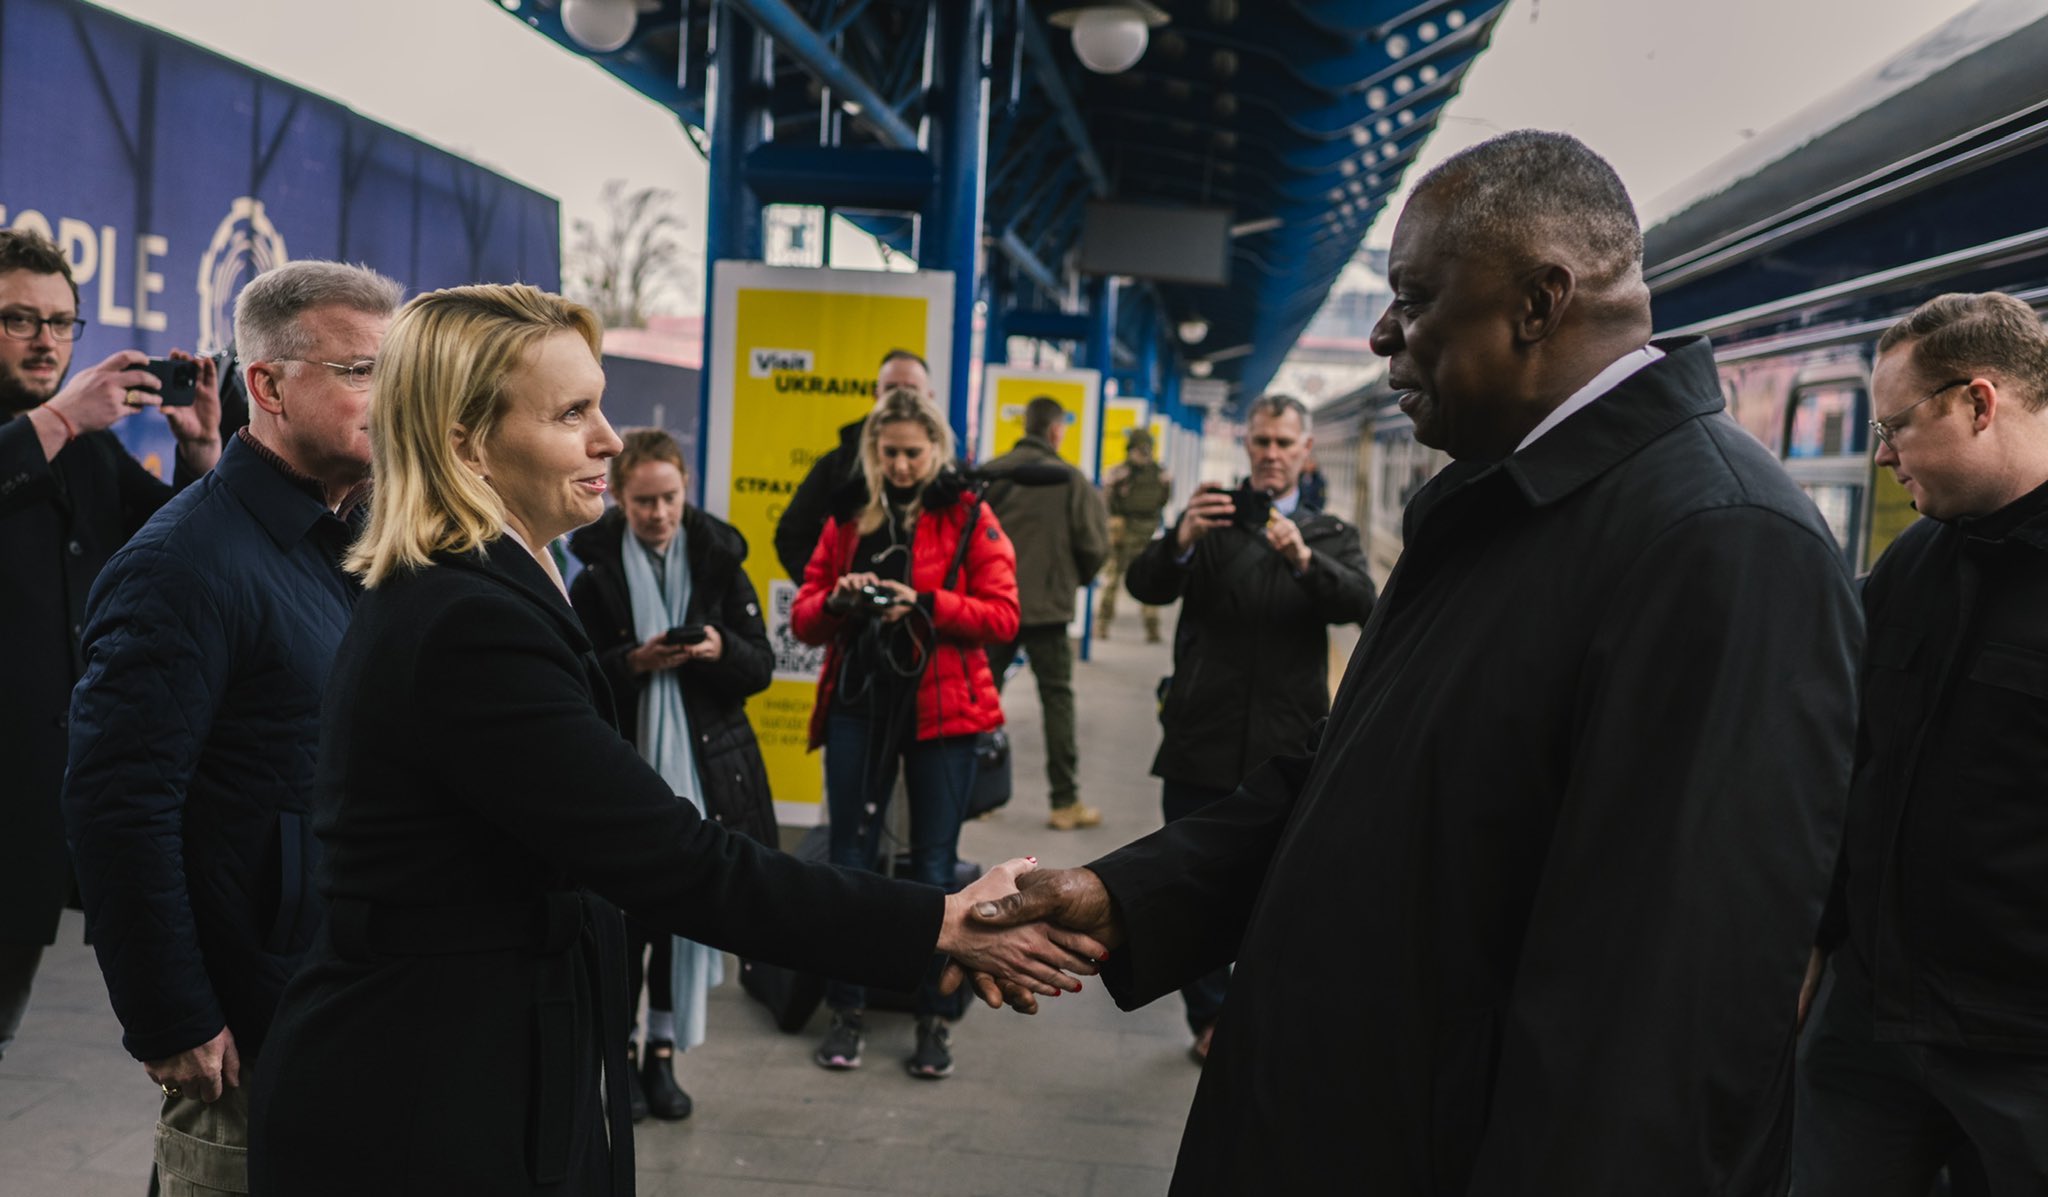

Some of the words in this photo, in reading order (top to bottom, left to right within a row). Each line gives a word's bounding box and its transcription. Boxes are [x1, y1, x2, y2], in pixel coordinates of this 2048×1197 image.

[0, 204, 168, 332] PLE
[756, 352, 805, 371] Visit
[734, 476, 798, 495] СТРАХ
